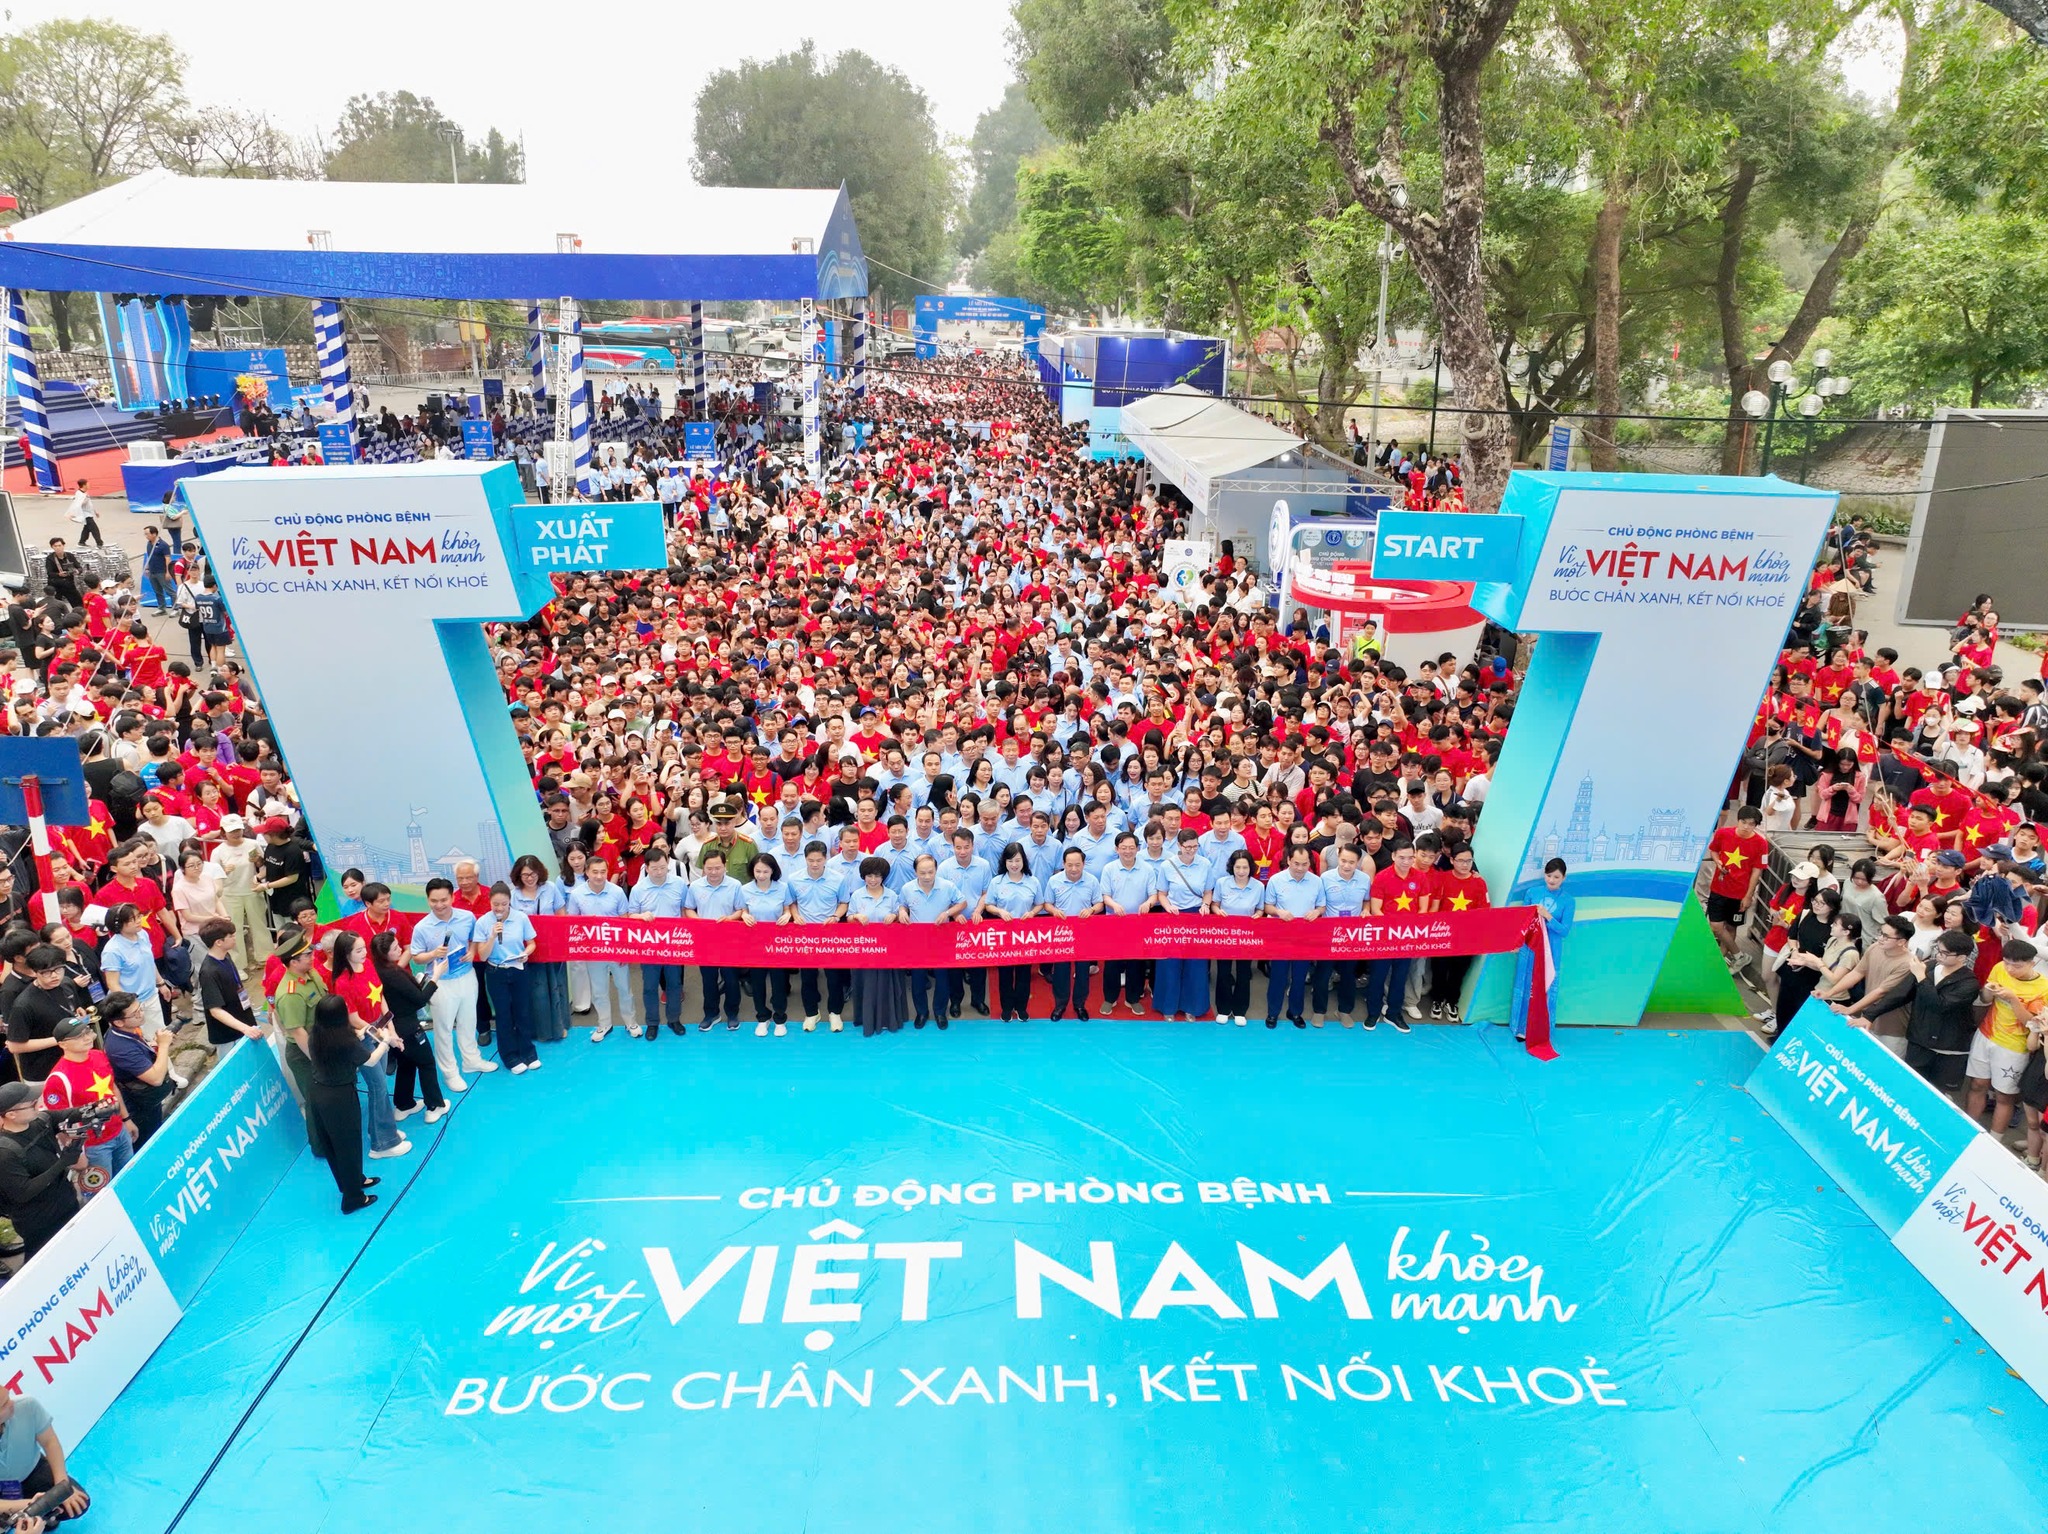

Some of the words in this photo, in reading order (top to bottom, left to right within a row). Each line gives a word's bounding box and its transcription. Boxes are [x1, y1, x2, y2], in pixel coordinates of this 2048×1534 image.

[275, 514, 301, 525] CHỦ
[305, 514, 342, 526] ĐỘNG
[347, 512, 392, 523] PHÒNG
[396, 510, 430, 523] BỆNH
[536, 511, 613, 539] XUẤT
[232, 537, 249, 555] Vì
[442, 529, 480, 552] khỏe
[1608, 525, 1633, 537] CHỦ
[1636, 525, 1672, 539] ĐỘNG
[1676, 526, 1719, 539] PHÒNG
[1722, 527, 1754, 542] BỆNH
[258, 530, 338, 575] VIỆT
[350, 537, 436, 565] NAM
[532, 539, 608, 565] PHÁT
[1383, 535, 1484, 559] START
[1559, 545, 1577, 564] Vì
[233, 553, 267, 575] một
[440, 552, 485, 568] mạnh
[1554, 561, 1587, 582] một
[1585, 541, 1660, 586] VIỆT
[1668, 552, 1749, 582] NAM
[1752, 548, 1790, 572] khỏe
[235, 578, 279, 593] BƯỚC
[284, 578, 327, 592] CHÂN
[332, 578, 379, 591] XANH,
[384, 574, 409, 590] KẾT
[415, 573, 443, 588] NỐI
[1748, 571, 1790, 586] mạnh
[1549, 588, 1590, 602] BƯỚC
[1594, 589, 1635, 602] CHÂN
[1639, 592, 1683, 605] XANH,
[1687, 590, 1713, 605] KẾT
[1716, 590, 1743, 606] NỐI
[582, 922, 623, 945] VIỆT
[628, 928, 670, 944] NAM
[795, 936, 819, 945] ĐỘNG
[822, 936, 851, 944] PHÒNG
[854, 936, 877, 945] BỆNH
[969, 927, 1007, 950] VIỆT
[1011, 929, 1051, 945] NAM
[1346, 923, 1384, 945] VIỆT
[1388, 925, 1429, 940] NAM
[1784, 1036, 1802, 1054] Vì
[1825, 1043, 1844, 1061] CHỦ
[1841, 1057, 1866, 1081] ĐỘNG
[1863, 1078, 1895, 1108] PHÒNG
[1893, 1104, 1920, 1130] BỆNH
[1797, 1050, 1848, 1106] VIỆT
[1839, 1096, 1905, 1165] NAM
[167, 1155, 185, 1180] CHỦ
[184, 1130, 208, 1161] ĐỘNG
[206, 1102, 232, 1135] PHÒNG
[230, 1081, 250, 1104] BỆNH
[165, 1156, 219, 1225] VIỆT
[217, 1102, 268, 1173] NAM
[738, 1179, 840, 1210] CHỦ
[853, 1179, 997, 1212] ĐỘNG
[1011, 1175, 1185, 1205] PHÒNG
[1197, 1176, 1333, 1210] BỆNH
[1944, 1182, 1966, 1203] Vì
[1931, 1199, 1965, 1224] một
[1999, 1196, 2024, 1219] CHỦ
[1963, 1201, 2032, 1275] VIỆT
[518, 1237, 607, 1295] Vì
[1387, 1225, 1544, 1289] khỏe
[107, 1254, 139, 1292] khỏe
[641, 1218, 963, 1352] VIỆT
[1013, 1238, 1374, 1321] NAM
[115, 1266, 147, 1308] mạnh
[18, 1294, 59, 1340] PHÒNG
[59, 1262, 90, 1297] BỆNH
[1390, 1289, 1578, 1336] mạnh
[483, 1279, 646, 1351] một
[32, 1286, 114, 1385] NAM
[443, 1363, 652, 1417] BƯỚC
[671, 1361, 875, 1411] CHÂN
[895, 1364, 1119, 1410] XANH,
[1139, 1350, 1258, 1402] KẾT
[1281, 1350, 1415, 1402] NỐI
[1428, 1354, 1628, 1407] KHOẺ
